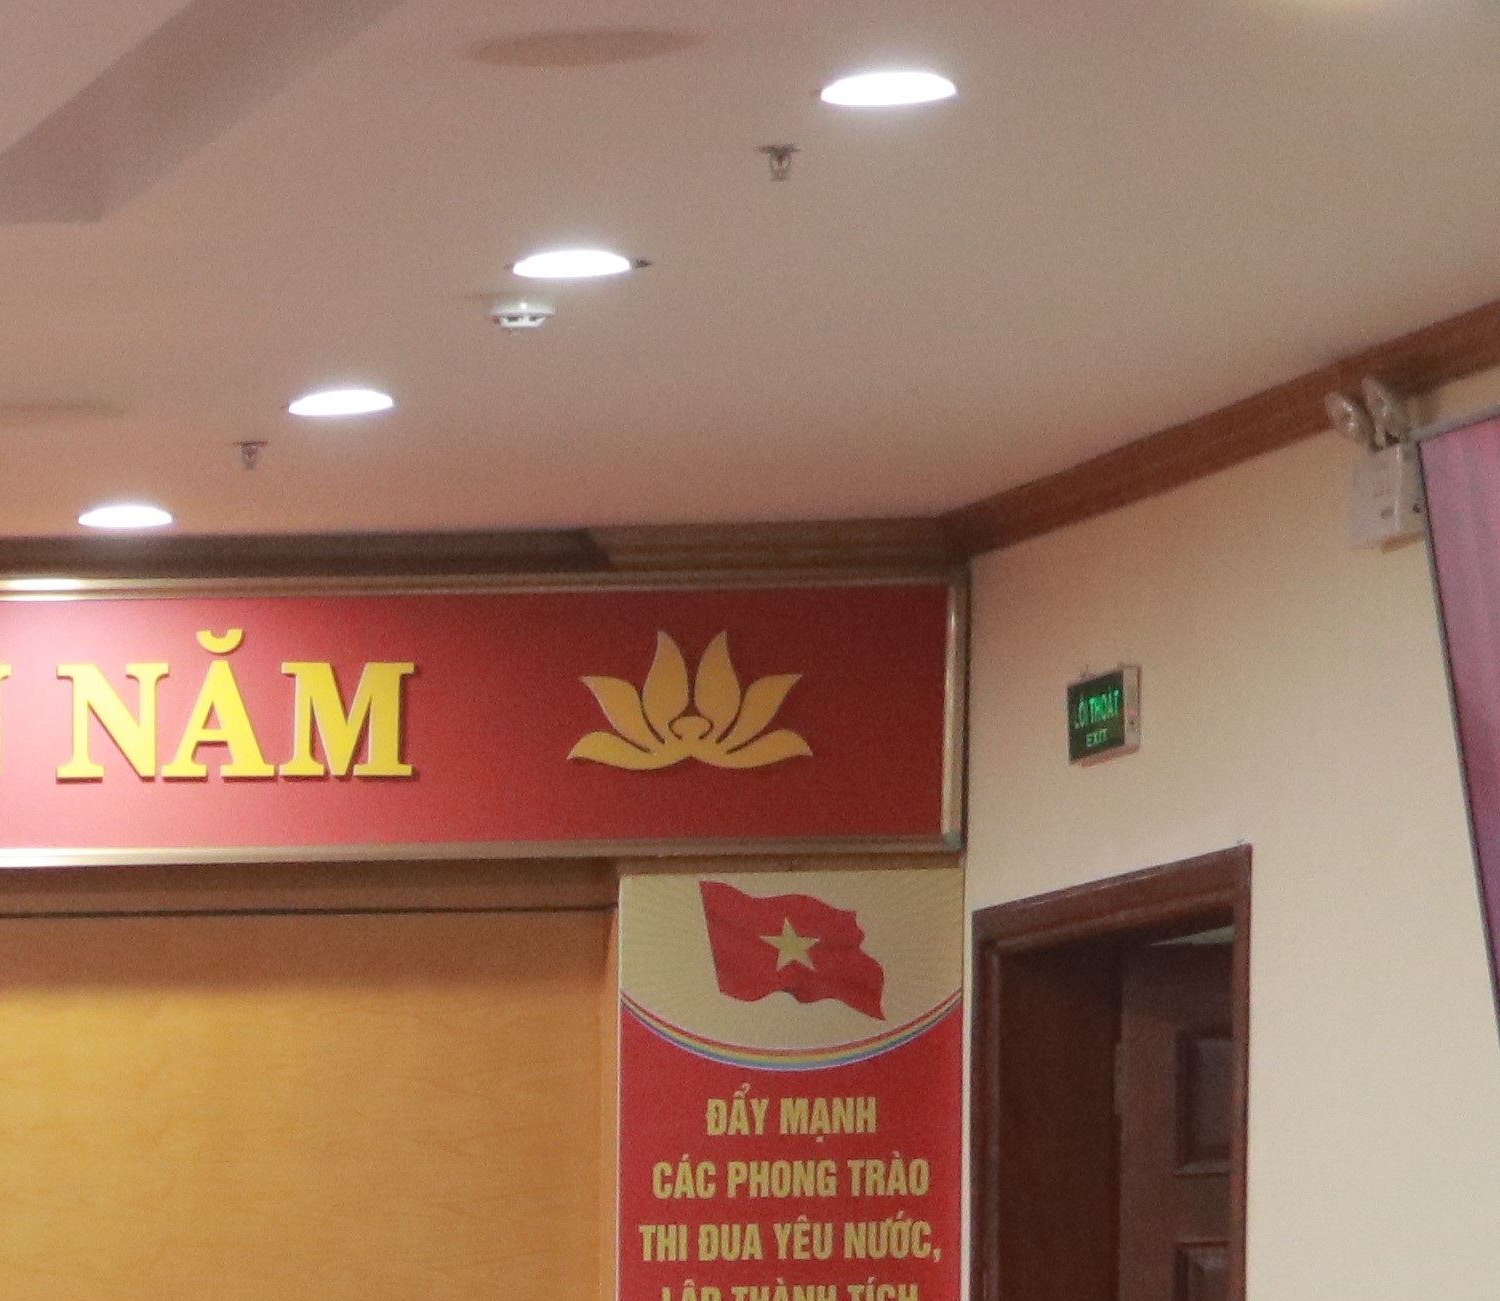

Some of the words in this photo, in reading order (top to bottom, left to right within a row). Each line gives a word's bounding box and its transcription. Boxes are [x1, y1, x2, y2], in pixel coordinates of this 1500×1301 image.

[57, 627, 413, 778] NĂM
[1086, 728, 1108, 748] EXIT
[706, 1084, 770, 1137] ĐẨY
[781, 1098, 877, 1143] MẠNH
[653, 1155, 717, 1200] CÁC
[728, 1160, 838, 1199] PHONG
[848, 1153, 930, 1197] TRÀO
[639, 1225, 689, 1263] THI
[699, 1225, 764, 1262] ĐUA
[774, 1216, 834, 1260] YÊU
[845, 1212, 942, 1262] NƯỚC,
